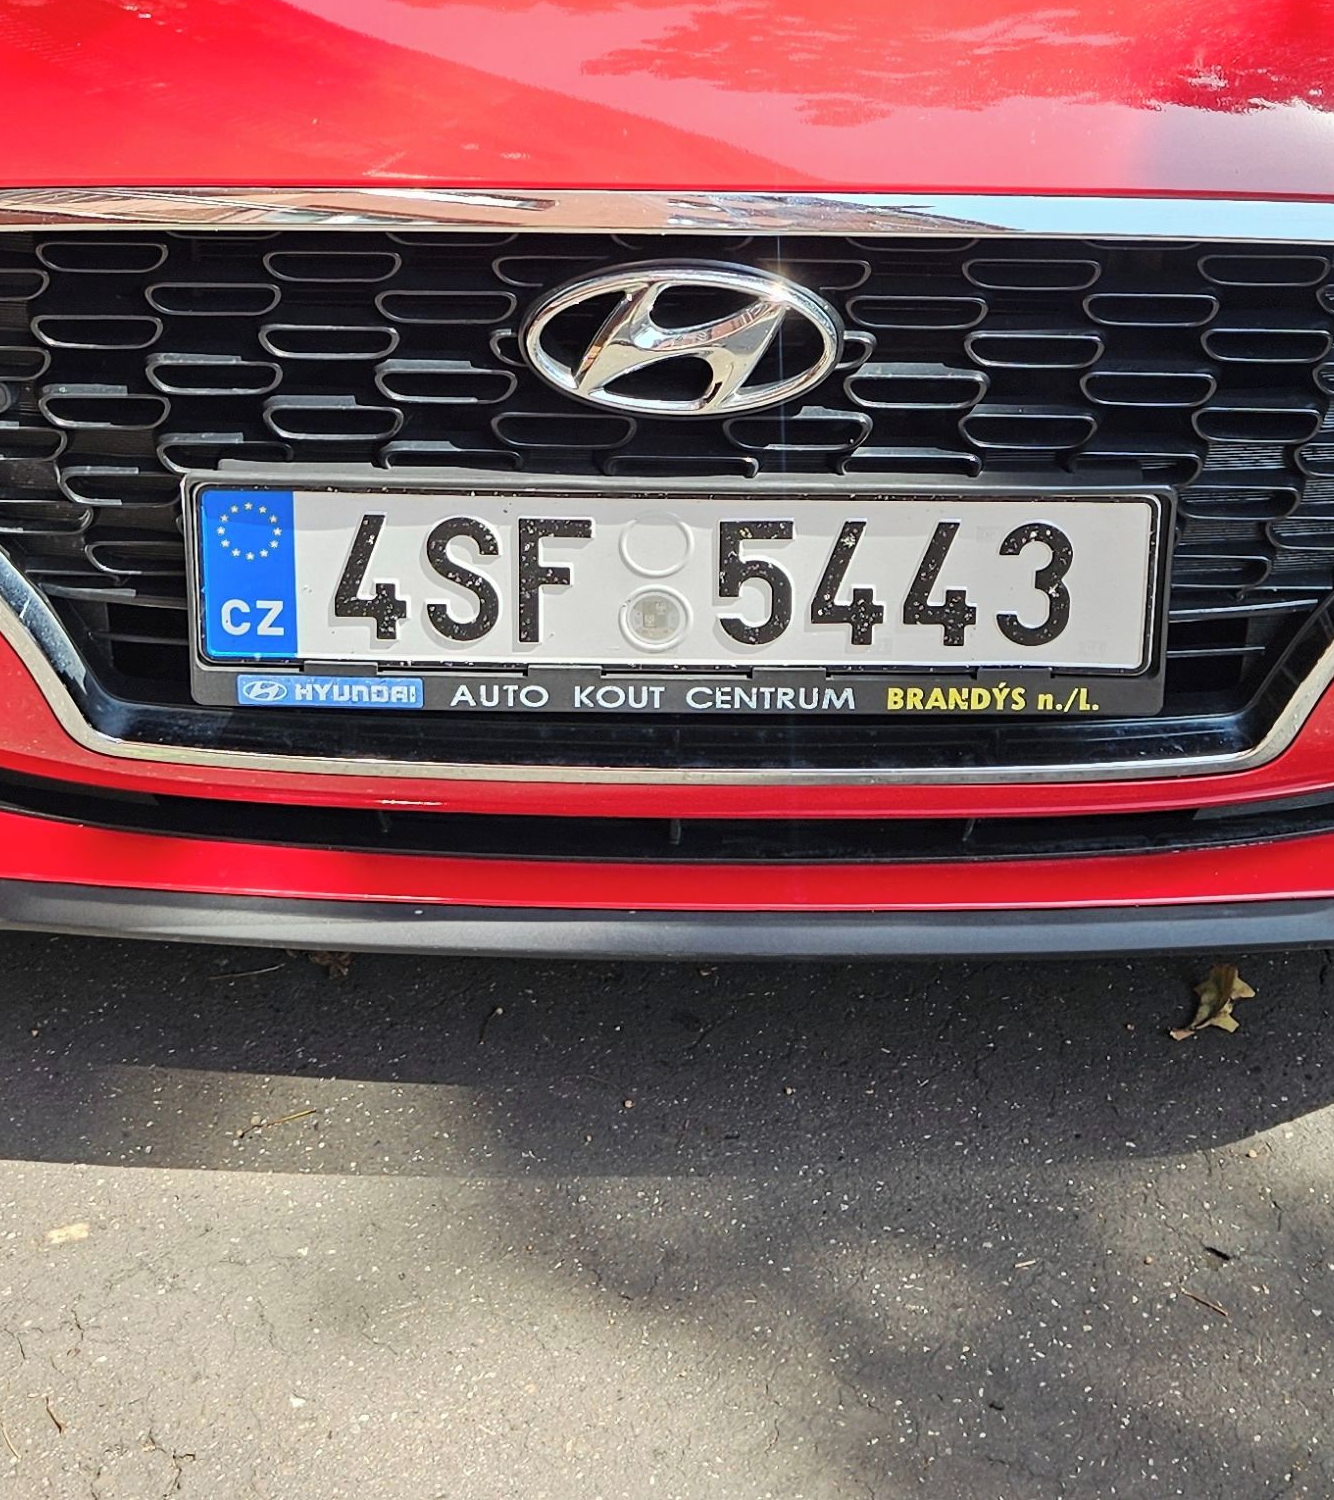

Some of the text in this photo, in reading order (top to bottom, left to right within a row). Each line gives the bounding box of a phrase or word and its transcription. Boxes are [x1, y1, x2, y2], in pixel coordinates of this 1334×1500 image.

[335, 514, 1073, 646] 4SF 5443
[221, 600, 284, 636] CZ
[295, 682, 416, 703] HYUNDAI
[450, 684, 549, 708] AUTO
[574, 685, 665, 709] KOUT
[686, 686, 856, 710] CENTRUM
[887, 682, 1026, 710] BRANDÝS
